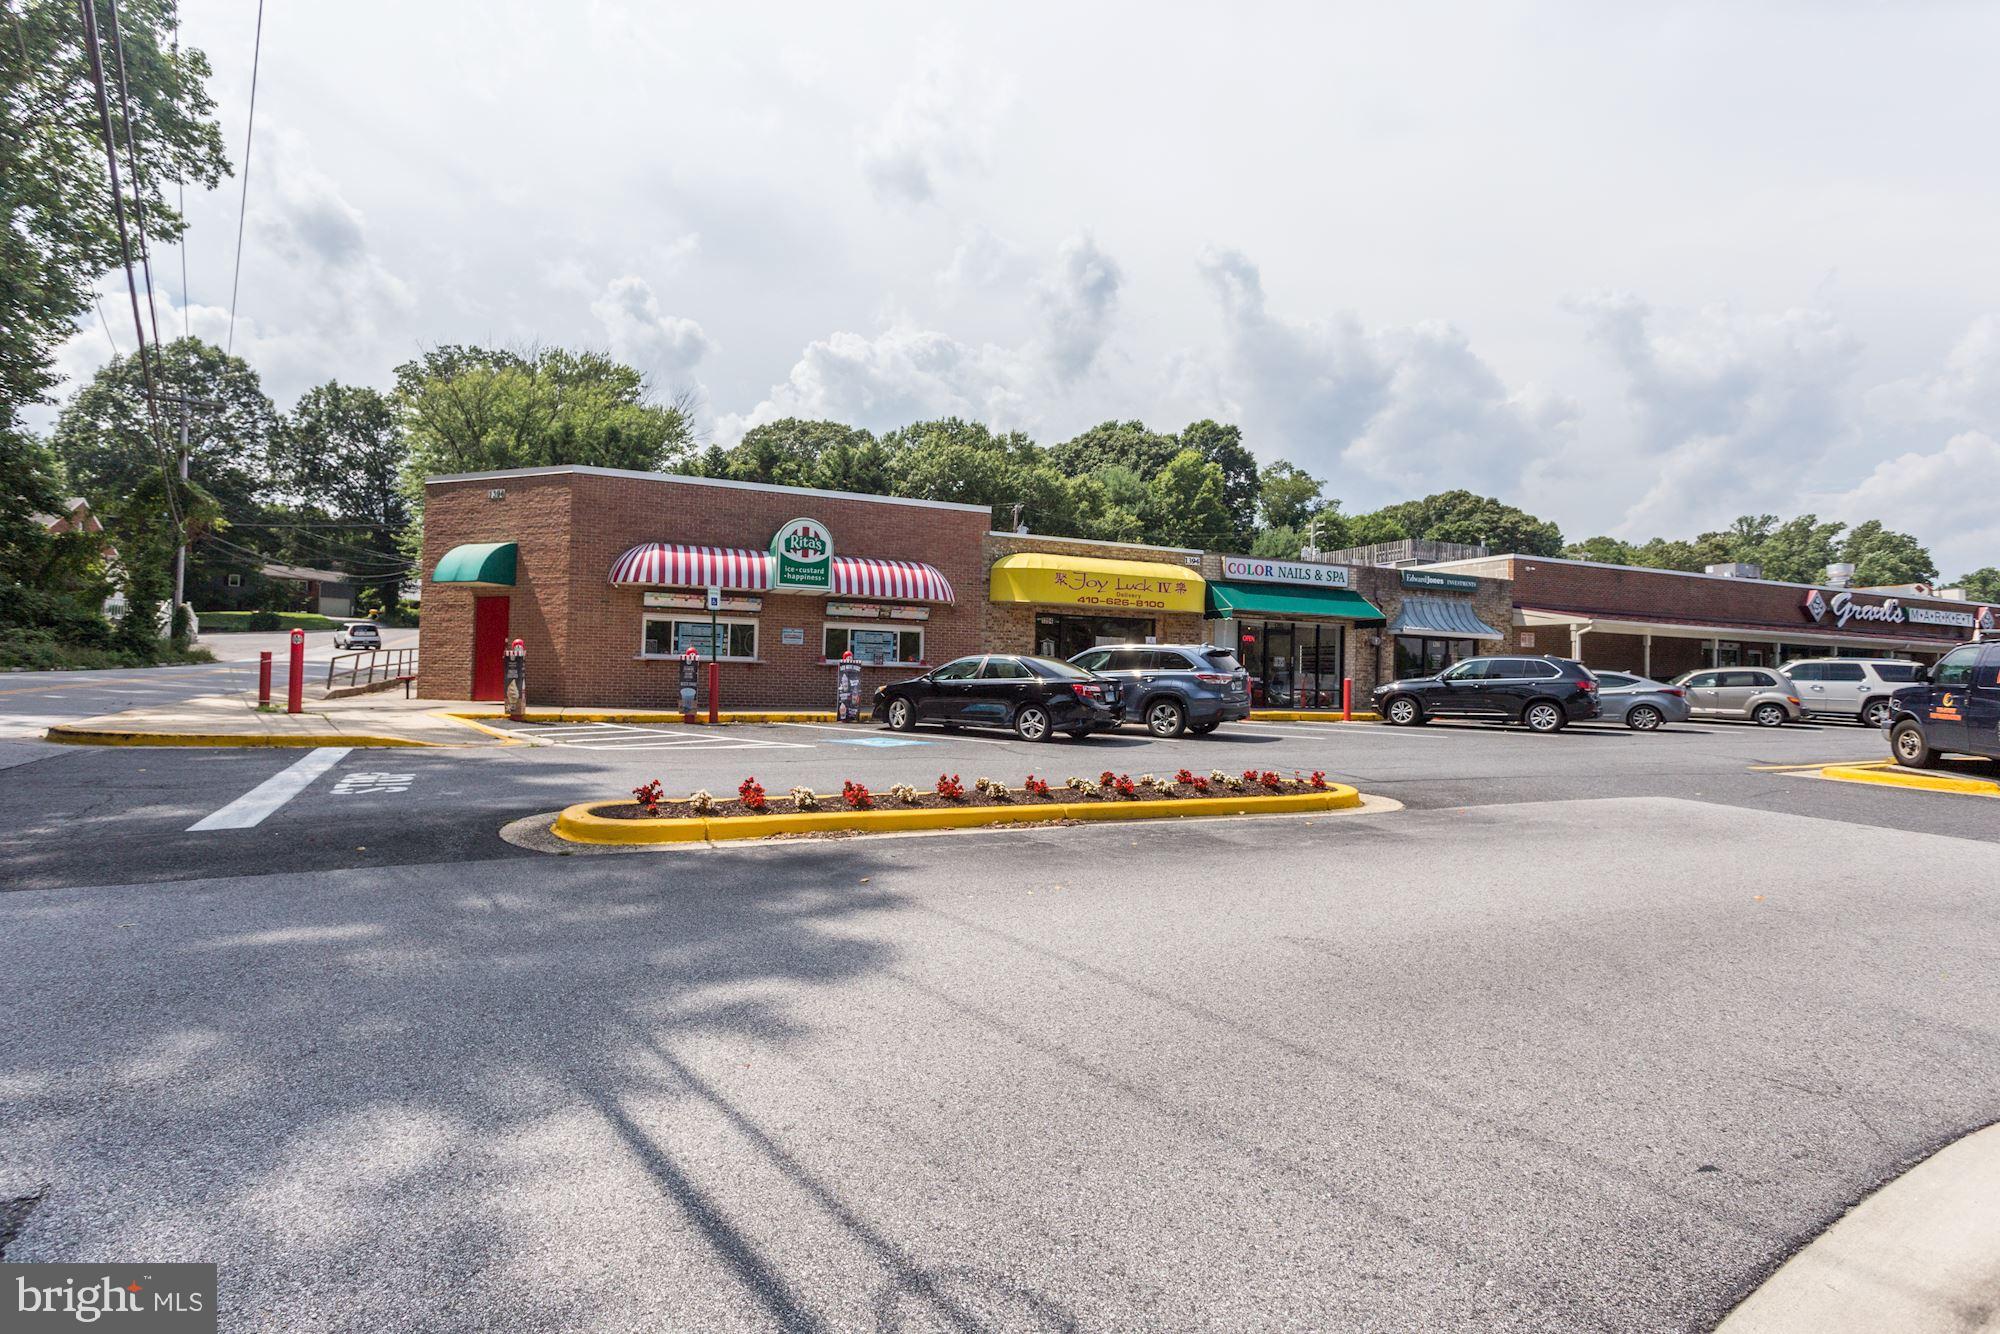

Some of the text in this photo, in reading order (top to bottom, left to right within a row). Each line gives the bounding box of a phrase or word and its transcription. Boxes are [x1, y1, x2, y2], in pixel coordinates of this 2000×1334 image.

[790, 535, 822, 550] Rita's
[787, 573, 821, 581] happiness
[1228, 562, 1345, 583] COLOR NAILS & SPA
[1069, 572, 1173, 593] Joy Luck IV
[1077, 596, 1165, 608] 410-626-8100
